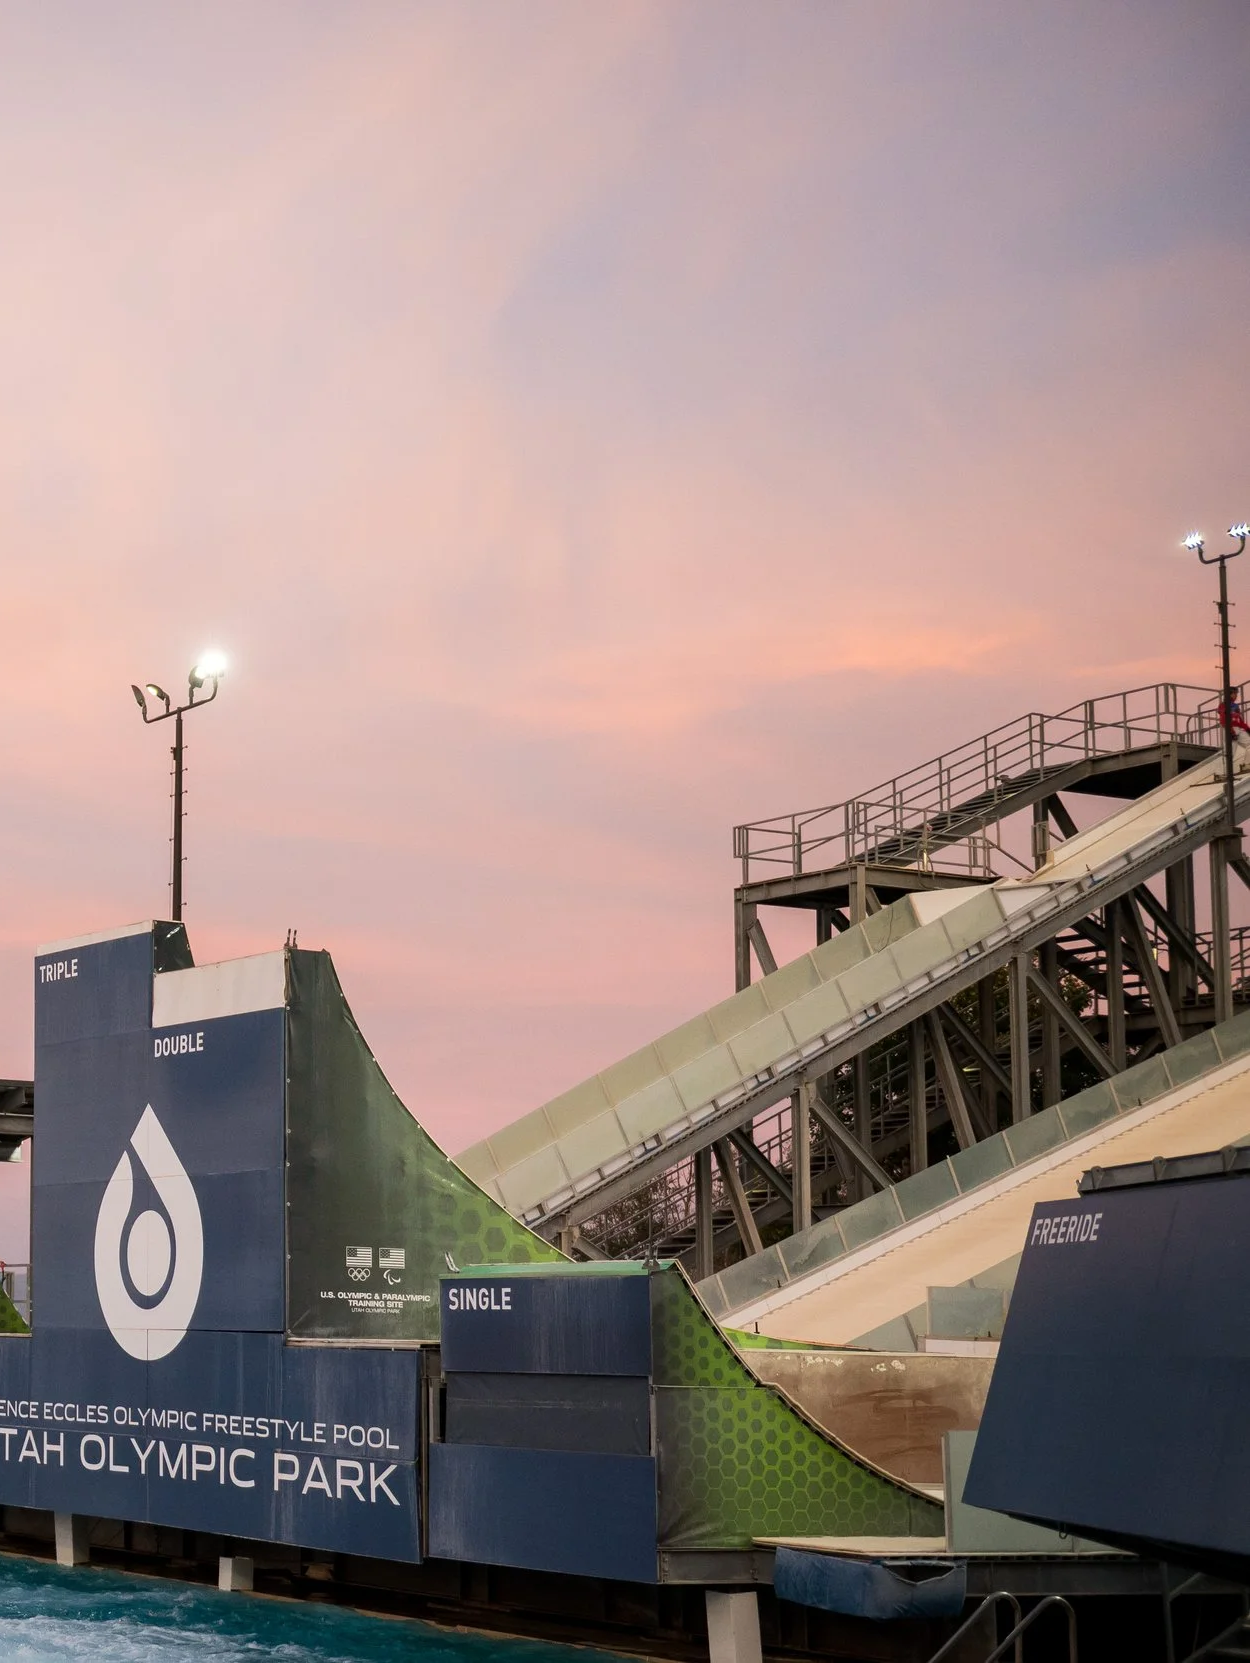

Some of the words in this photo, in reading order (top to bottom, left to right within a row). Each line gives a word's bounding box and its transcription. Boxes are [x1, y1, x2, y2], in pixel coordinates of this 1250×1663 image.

[39, 958, 79, 984] TRIPLE
[153, 1031, 204, 1059] DOUBLE
[1030, 1213, 1103, 1246] FREERIDE
[320, 1291, 336, 1299] U.S.
[337, 1291, 372, 1300] OLYMPIC
[381, 1293, 431, 1302] PARALYMPIC
[348, 1299, 385, 1308] TRAINING
[448, 1287, 512, 1311] SINGLE
[43, 1402, 109, 1425] ECCLES
[113, 1406, 198, 1431] OLYMPIC
[202, 1413, 327, 1444] FREESTYLE
[332, 1424, 400, 1450] POOL
[79, 1434, 256, 1488] OLYMPIC
[273, 1452, 401, 1506] PARK
